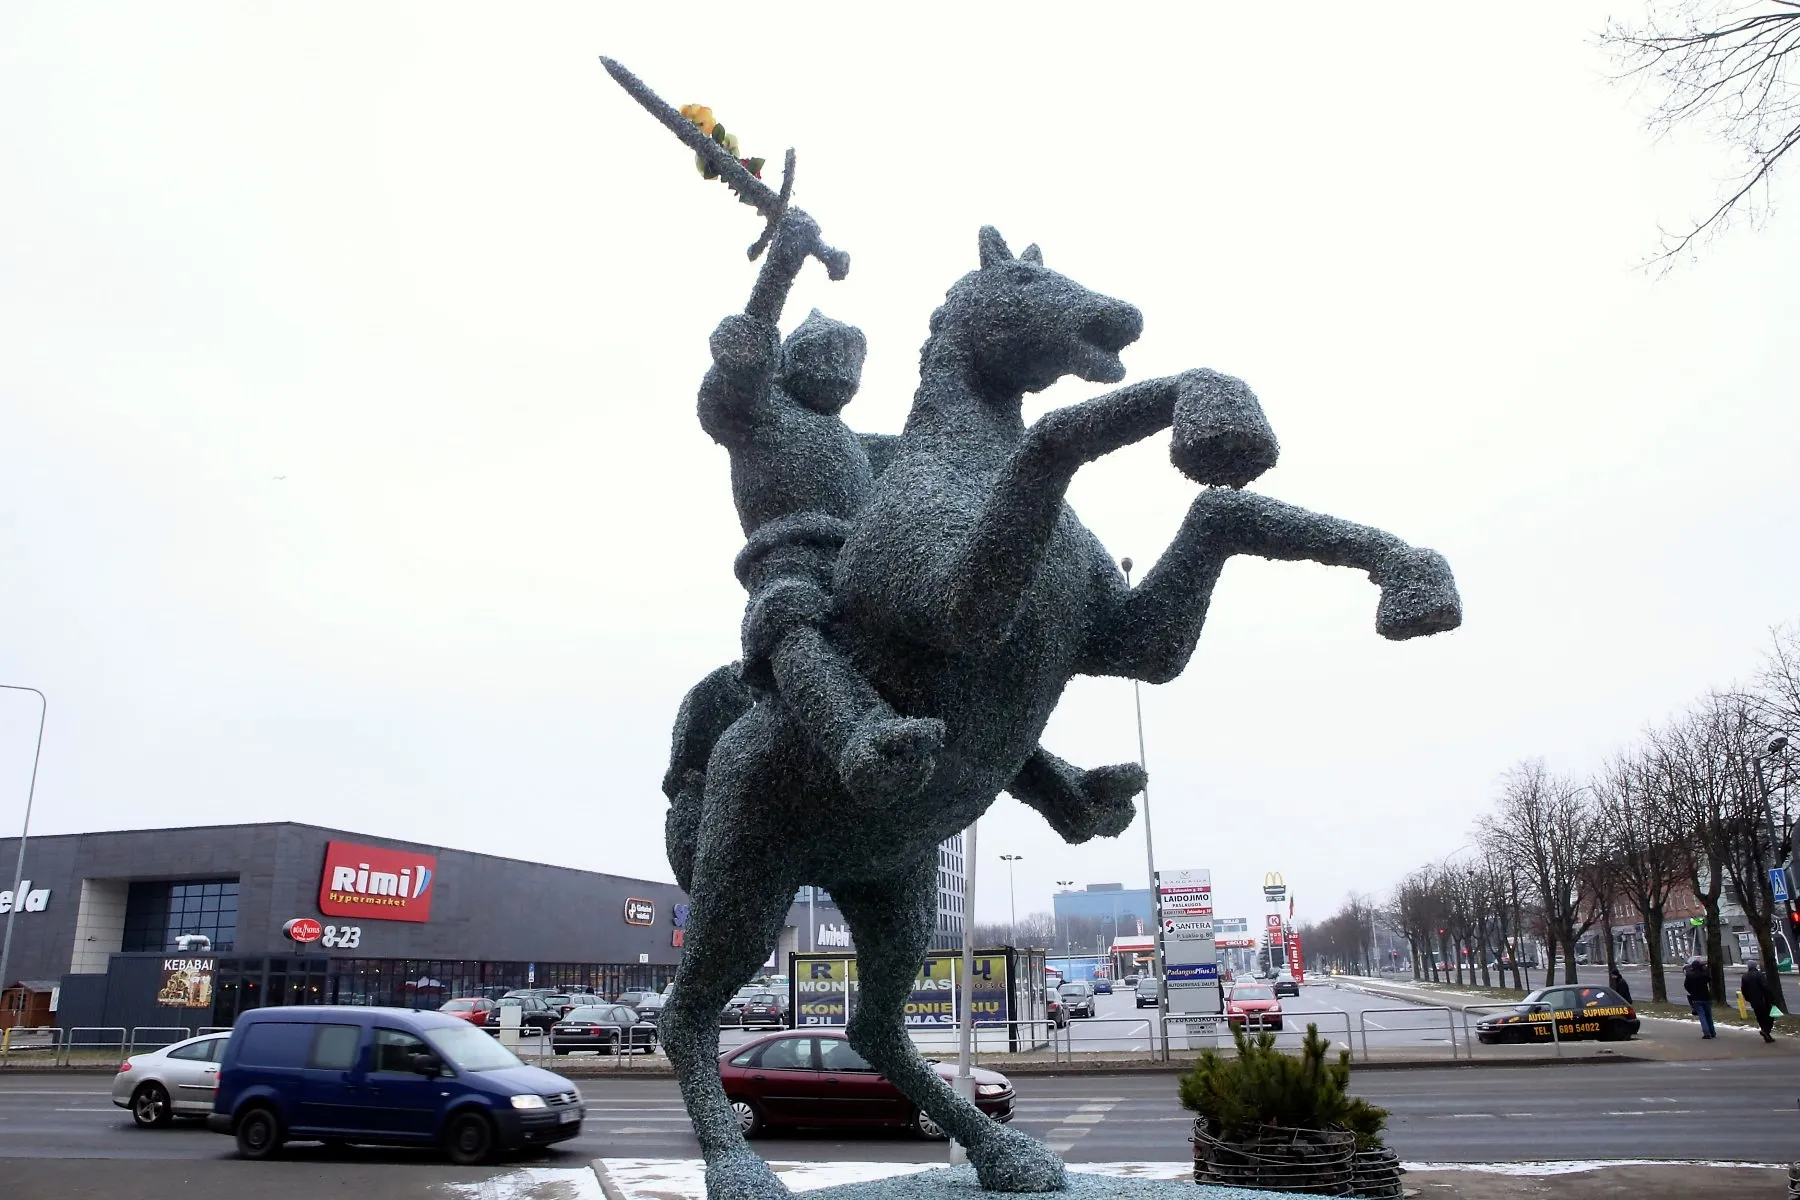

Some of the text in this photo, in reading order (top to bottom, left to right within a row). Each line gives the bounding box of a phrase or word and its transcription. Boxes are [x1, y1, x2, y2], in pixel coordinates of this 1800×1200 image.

[331, 863, 411, 897] Rimi
[329, 893, 406, 907] Hypermarket
[1164, 894, 1209, 903] LAIDOJIMO
[1176, 922, 1211, 930] SANTERA
[322, 926, 361, 948] 8-23
[164, 959, 213, 970] KEBABAI
[1167, 967, 1216, 977] PadangusPlius.lt
[1529, 1010, 1573, 1021] AUTOMBILIŲ
[1583, 1007, 1629, 1017] SUPIRKIMAS
[1534, 1023, 1600, 1035] TEL. 689 54022
